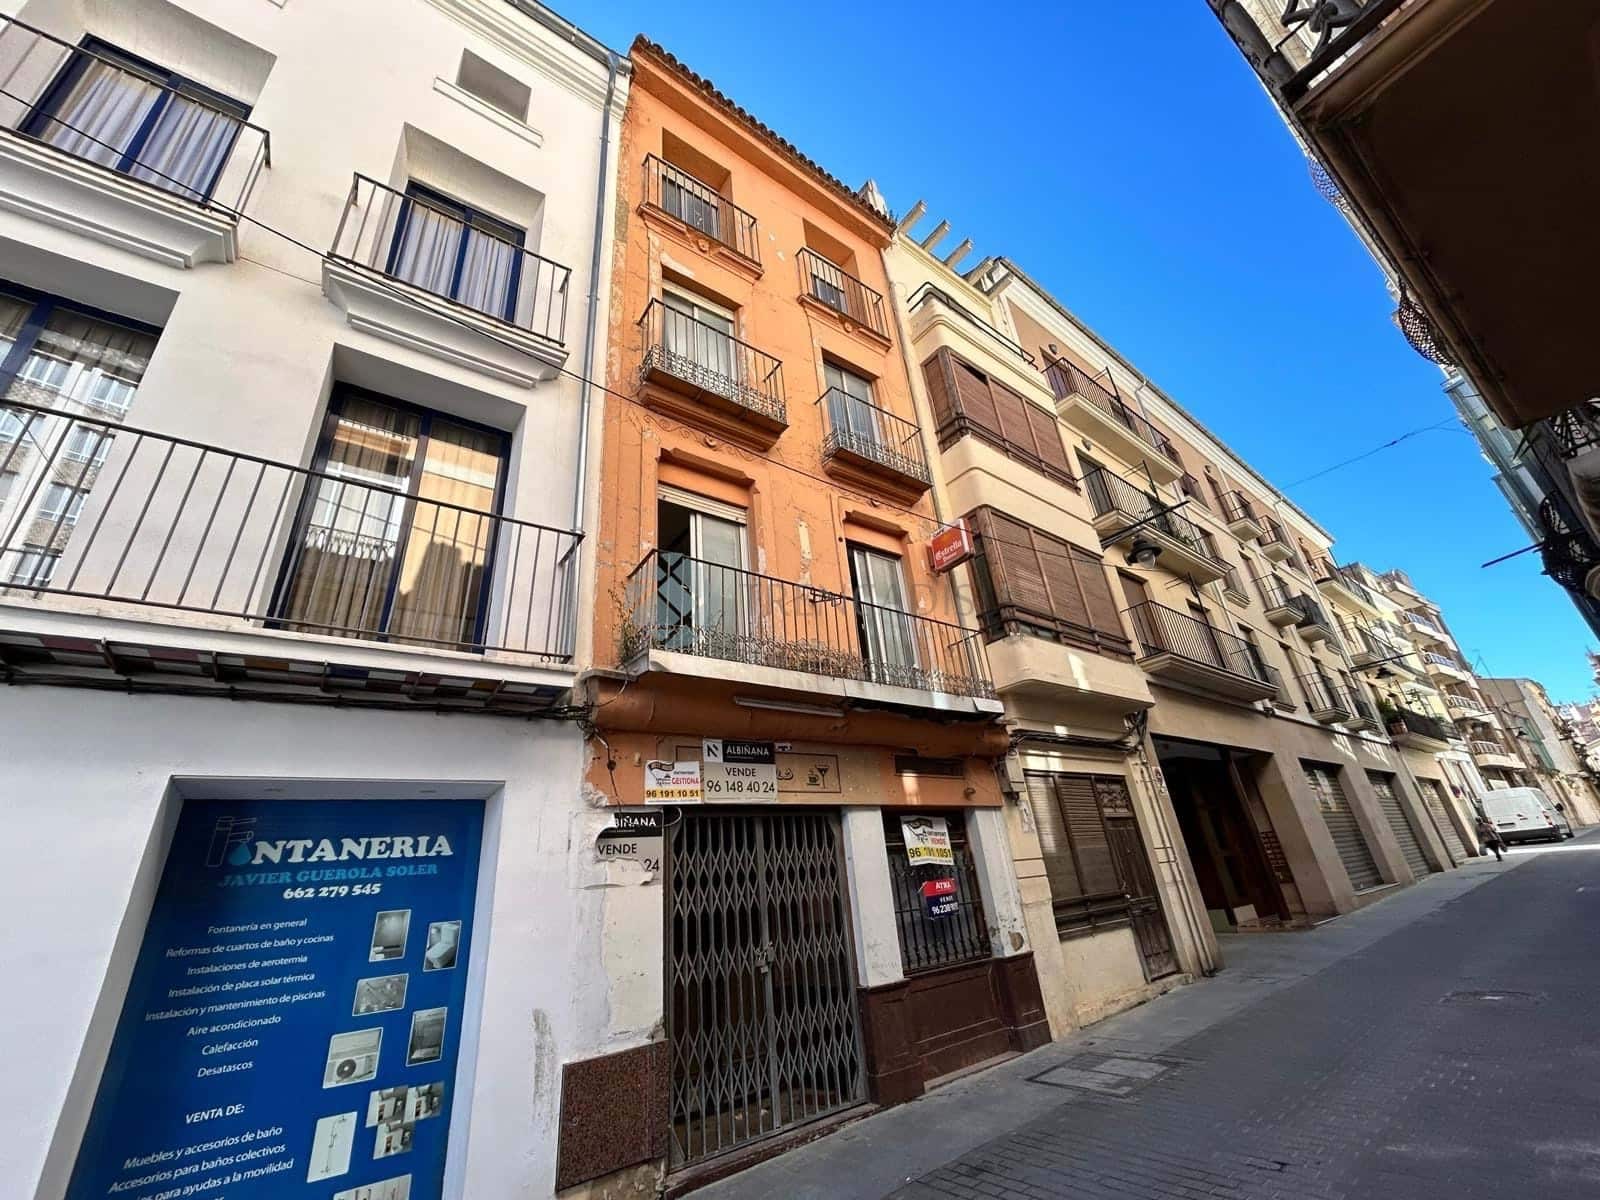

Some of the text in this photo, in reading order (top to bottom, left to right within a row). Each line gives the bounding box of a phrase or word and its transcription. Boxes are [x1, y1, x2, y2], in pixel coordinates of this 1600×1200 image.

[726, 745, 770, 756] ALBIÑANA
[725, 767, 757, 777] VENDE
[646, 789, 657, 798] 96
[660, 789, 674, 798] 191
[676, 789, 688, 798] 10
[706, 780, 775, 793] 96 148 40 24
[597, 843, 638, 855] VENDE
[908, 846, 921, 858] 96
[644, 857, 660, 872] 24
[219, 863, 439, 888] JAVIER GUEROLA SOLER
[283, 883, 382, 900] 662 279 545
[260, 923, 272, 931] en
[273, 917, 308, 931] general
[166, 934, 335, 959] Reformas de cuartos de baño y cocinas
[187, 954, 308, 976] Instalaciones de aerotermia
[168, 973, 316, 999] Instalación de placa solar térmica
[145, 989, 327, 1022] Instalación y mantenimiento de piscinas
[186, 1014, 283, 1038] Aire acondicionado
[201, 1038, 259, 1057] Calefacción
[197, 1060, 255, 1079] Desatascos
[185, 1103, 246, 1125] VENTA DE:
[123, 1126, 283, 1171] Muebles y accesorios de baño
[107, 1143, 287, 1195] Accesorios para baños colectivos
[182, 1176, 222, 1197] ayudas
[223, 1175, 231, 1185] a
[232, 1171, 242, 1182] la
[243, 1158, 295, 1180] movilidad
